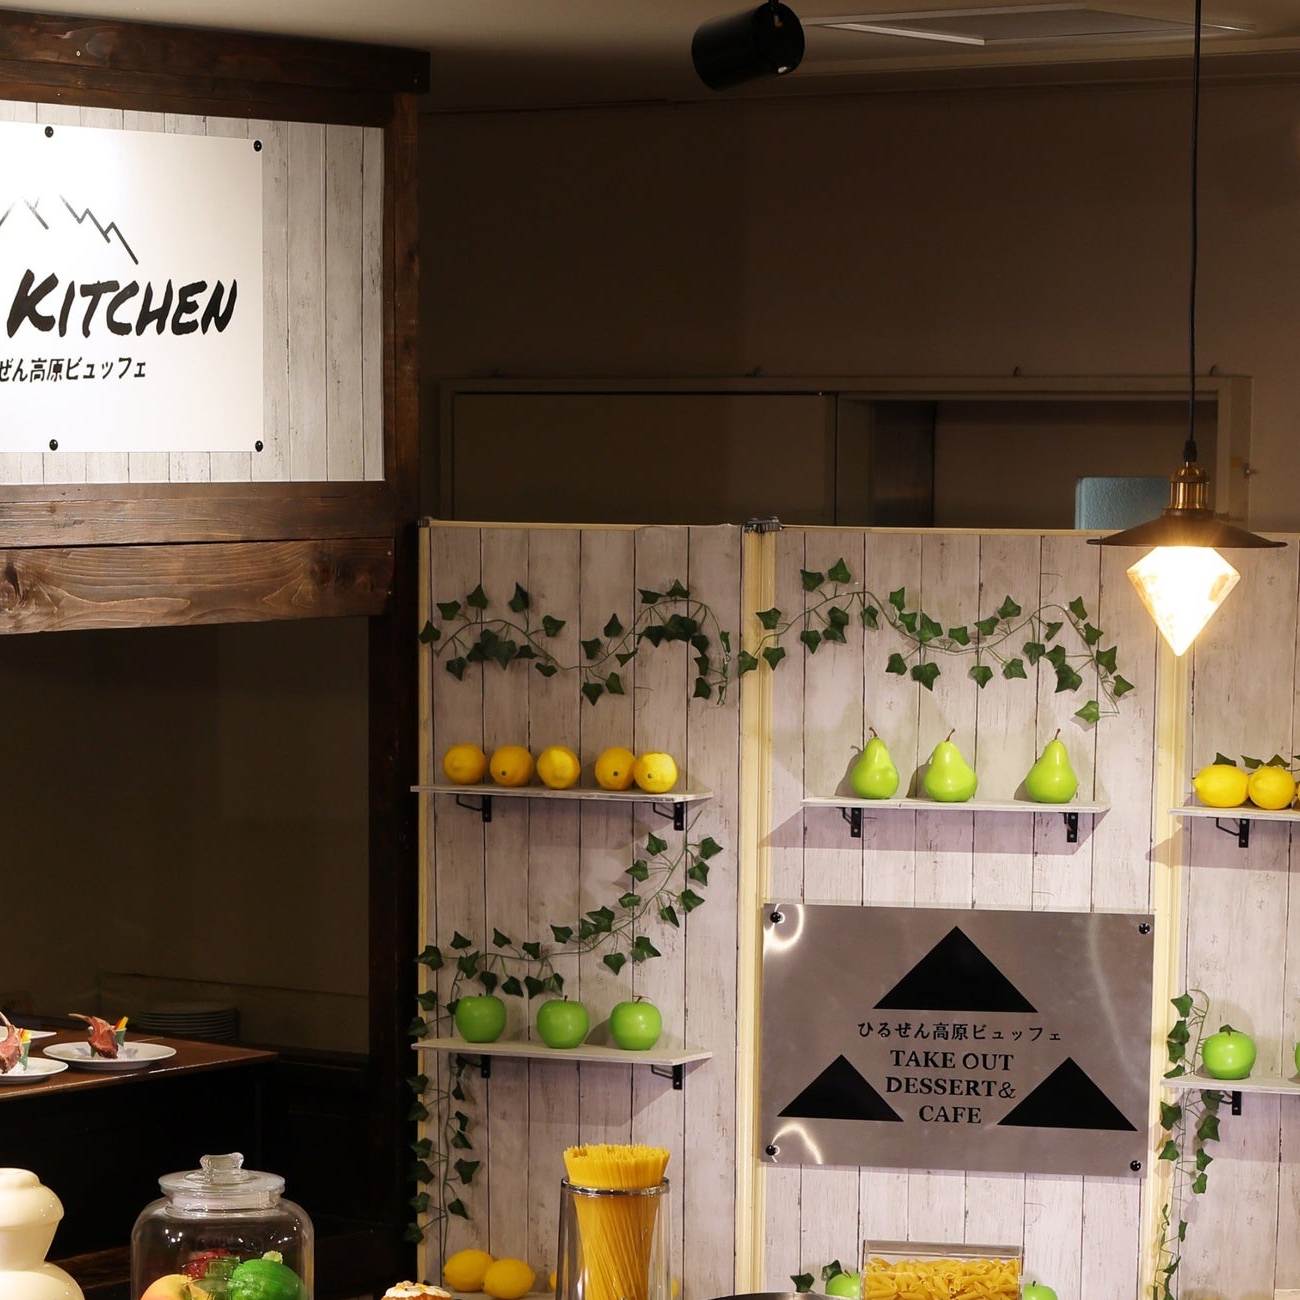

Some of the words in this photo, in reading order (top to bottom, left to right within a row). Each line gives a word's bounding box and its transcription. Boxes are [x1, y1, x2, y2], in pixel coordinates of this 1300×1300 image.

[7, 268, 238, 338] KITCHEN
[857, 1020, 1062, 1042] ひるぜん高原ビュッフェ
[890, 1049, 956, 1069] TAKE
[962, 1051, 1015, 1071] OUT
[918, 1104, 982, 1124] CAFE
